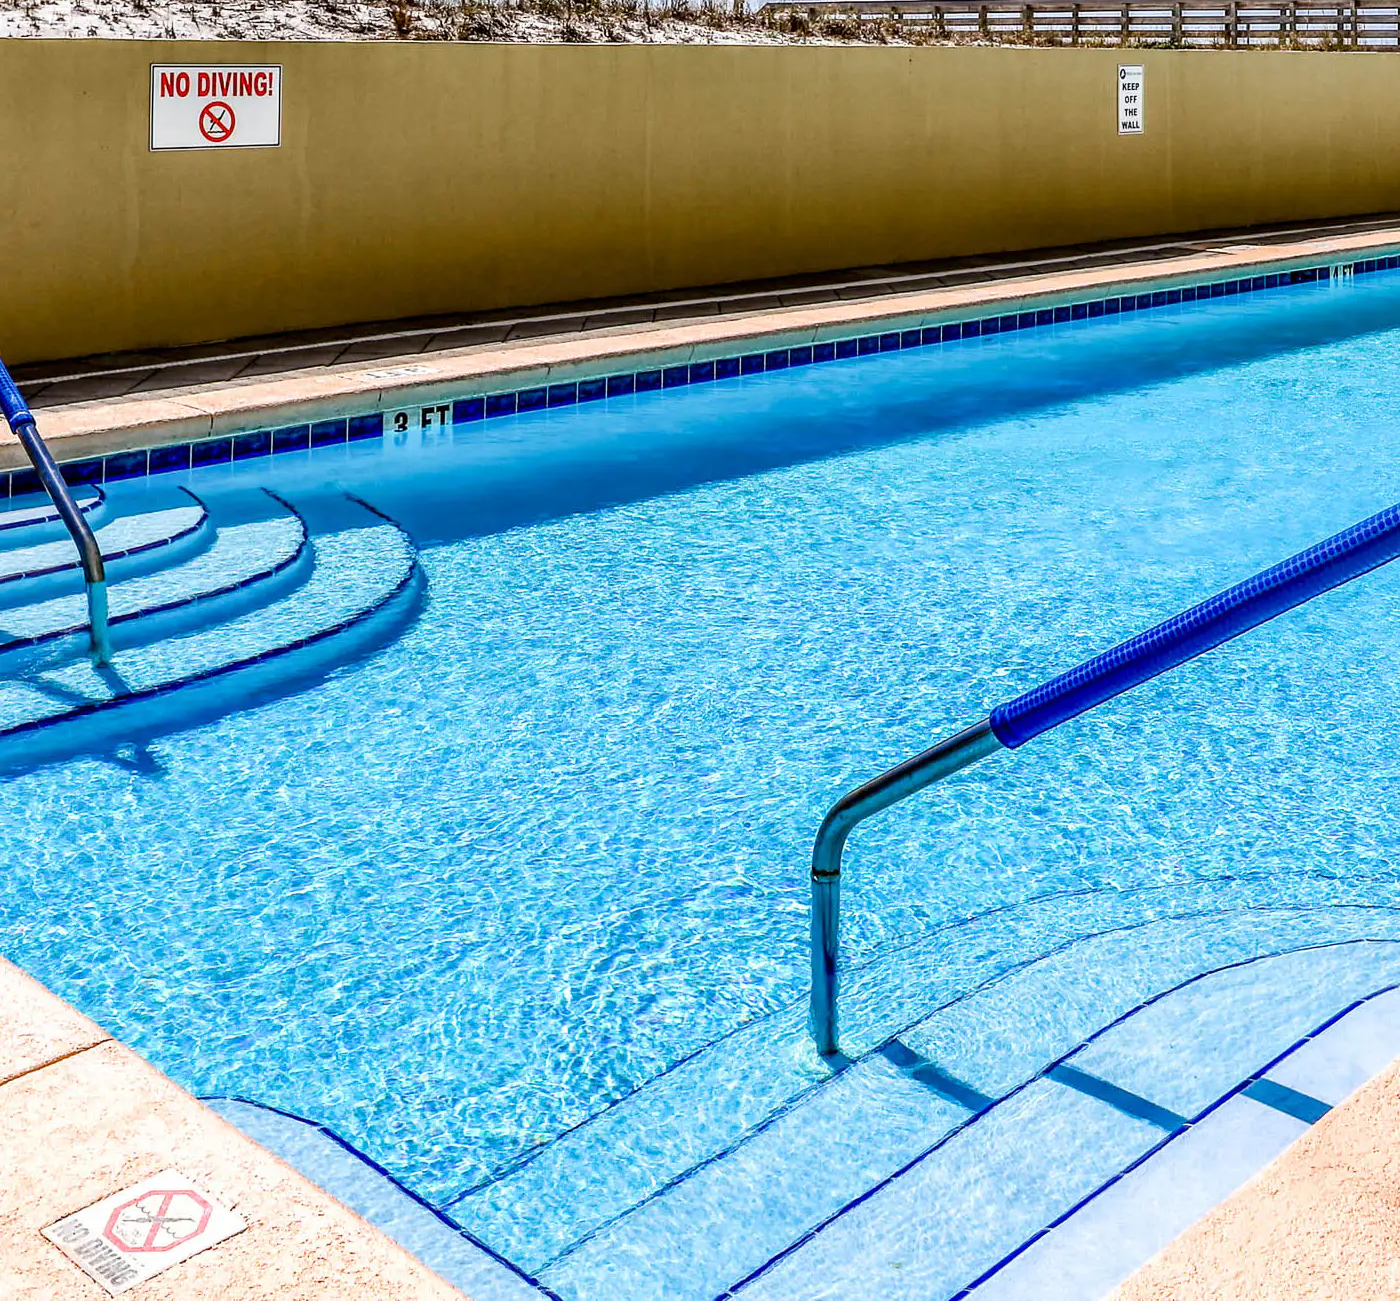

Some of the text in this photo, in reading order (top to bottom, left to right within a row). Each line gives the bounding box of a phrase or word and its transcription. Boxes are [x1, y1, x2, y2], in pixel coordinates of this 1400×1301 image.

[160, 72, 273, 97] NO DIVING!
[1122, 83, 1139, 91] KEEP
[1124, 95, 1138, 104] OFF
[1124, 108, 1138, 117] THE
[1121, 121, 1140, 130] WALL
[394, 405, 450, 432] 3 FT
[52, 1218, 139, 1287] NO DIVING
